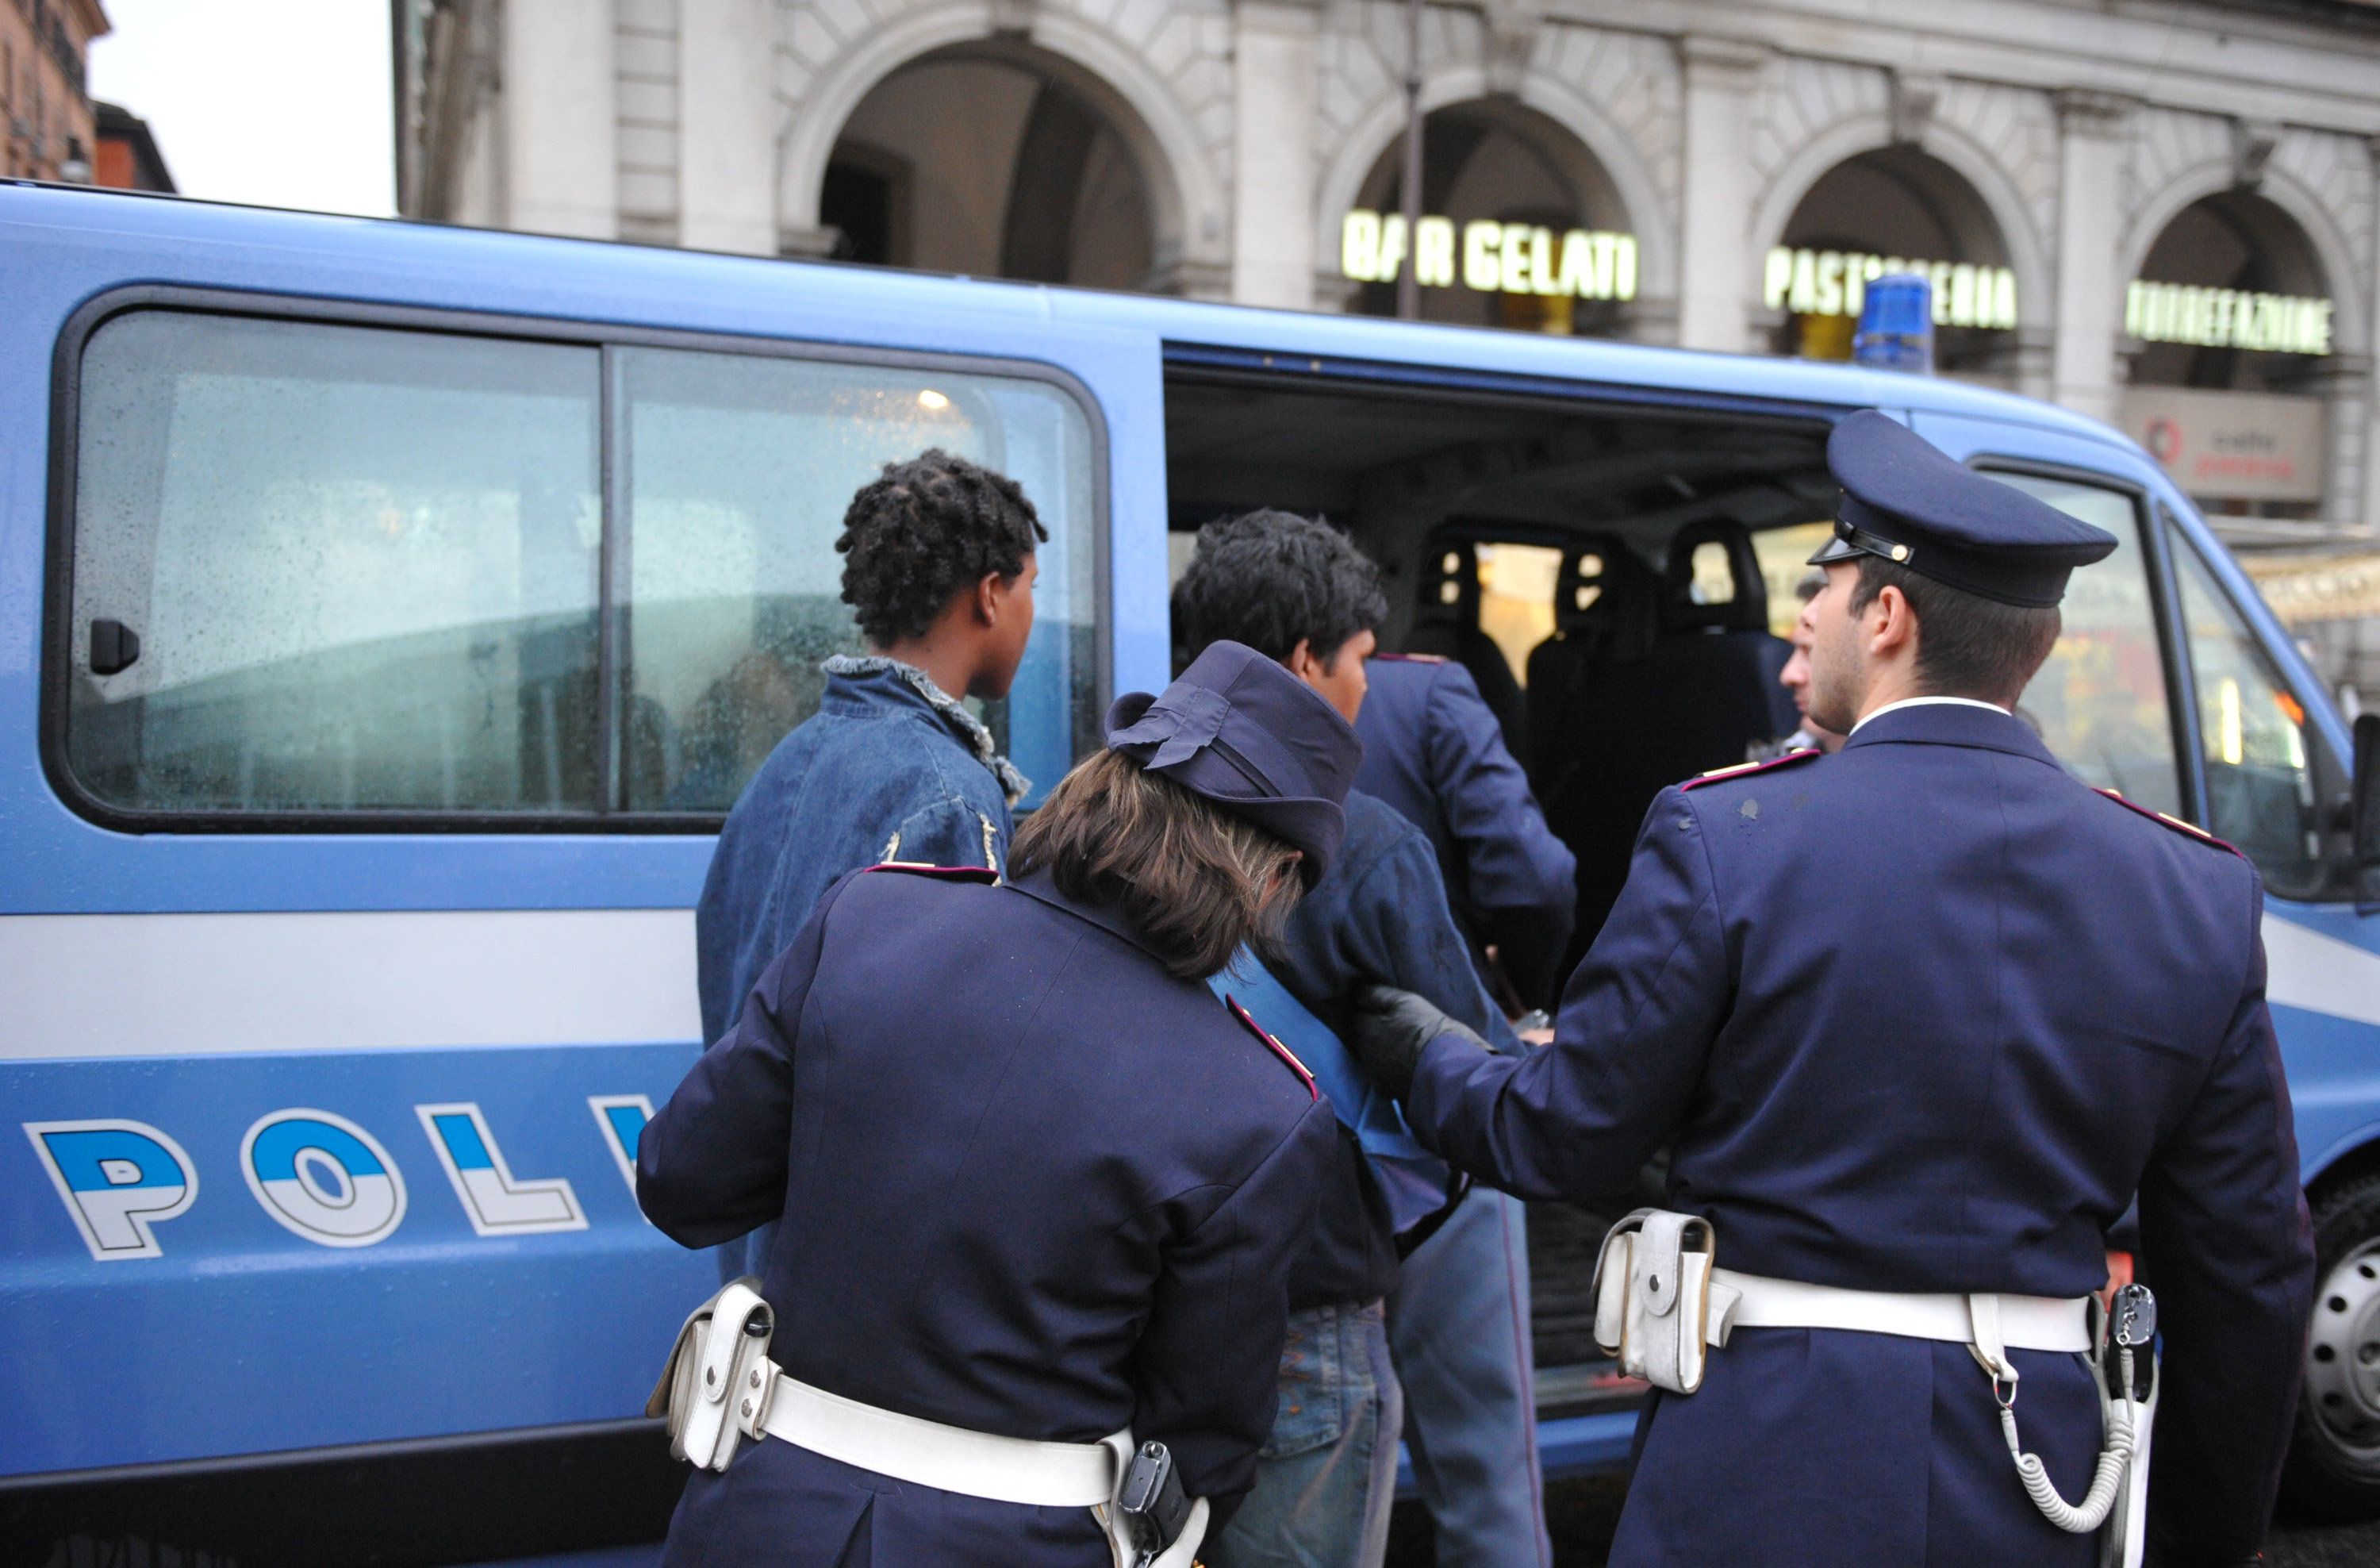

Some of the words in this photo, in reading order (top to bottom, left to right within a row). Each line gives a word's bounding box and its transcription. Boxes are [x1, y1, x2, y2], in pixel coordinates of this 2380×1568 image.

[1342, 209, 1455, 287] BAR
[1464, 219, 1637, 301] GELATI
[1764, 247, 2017, 330] PASTERIA
